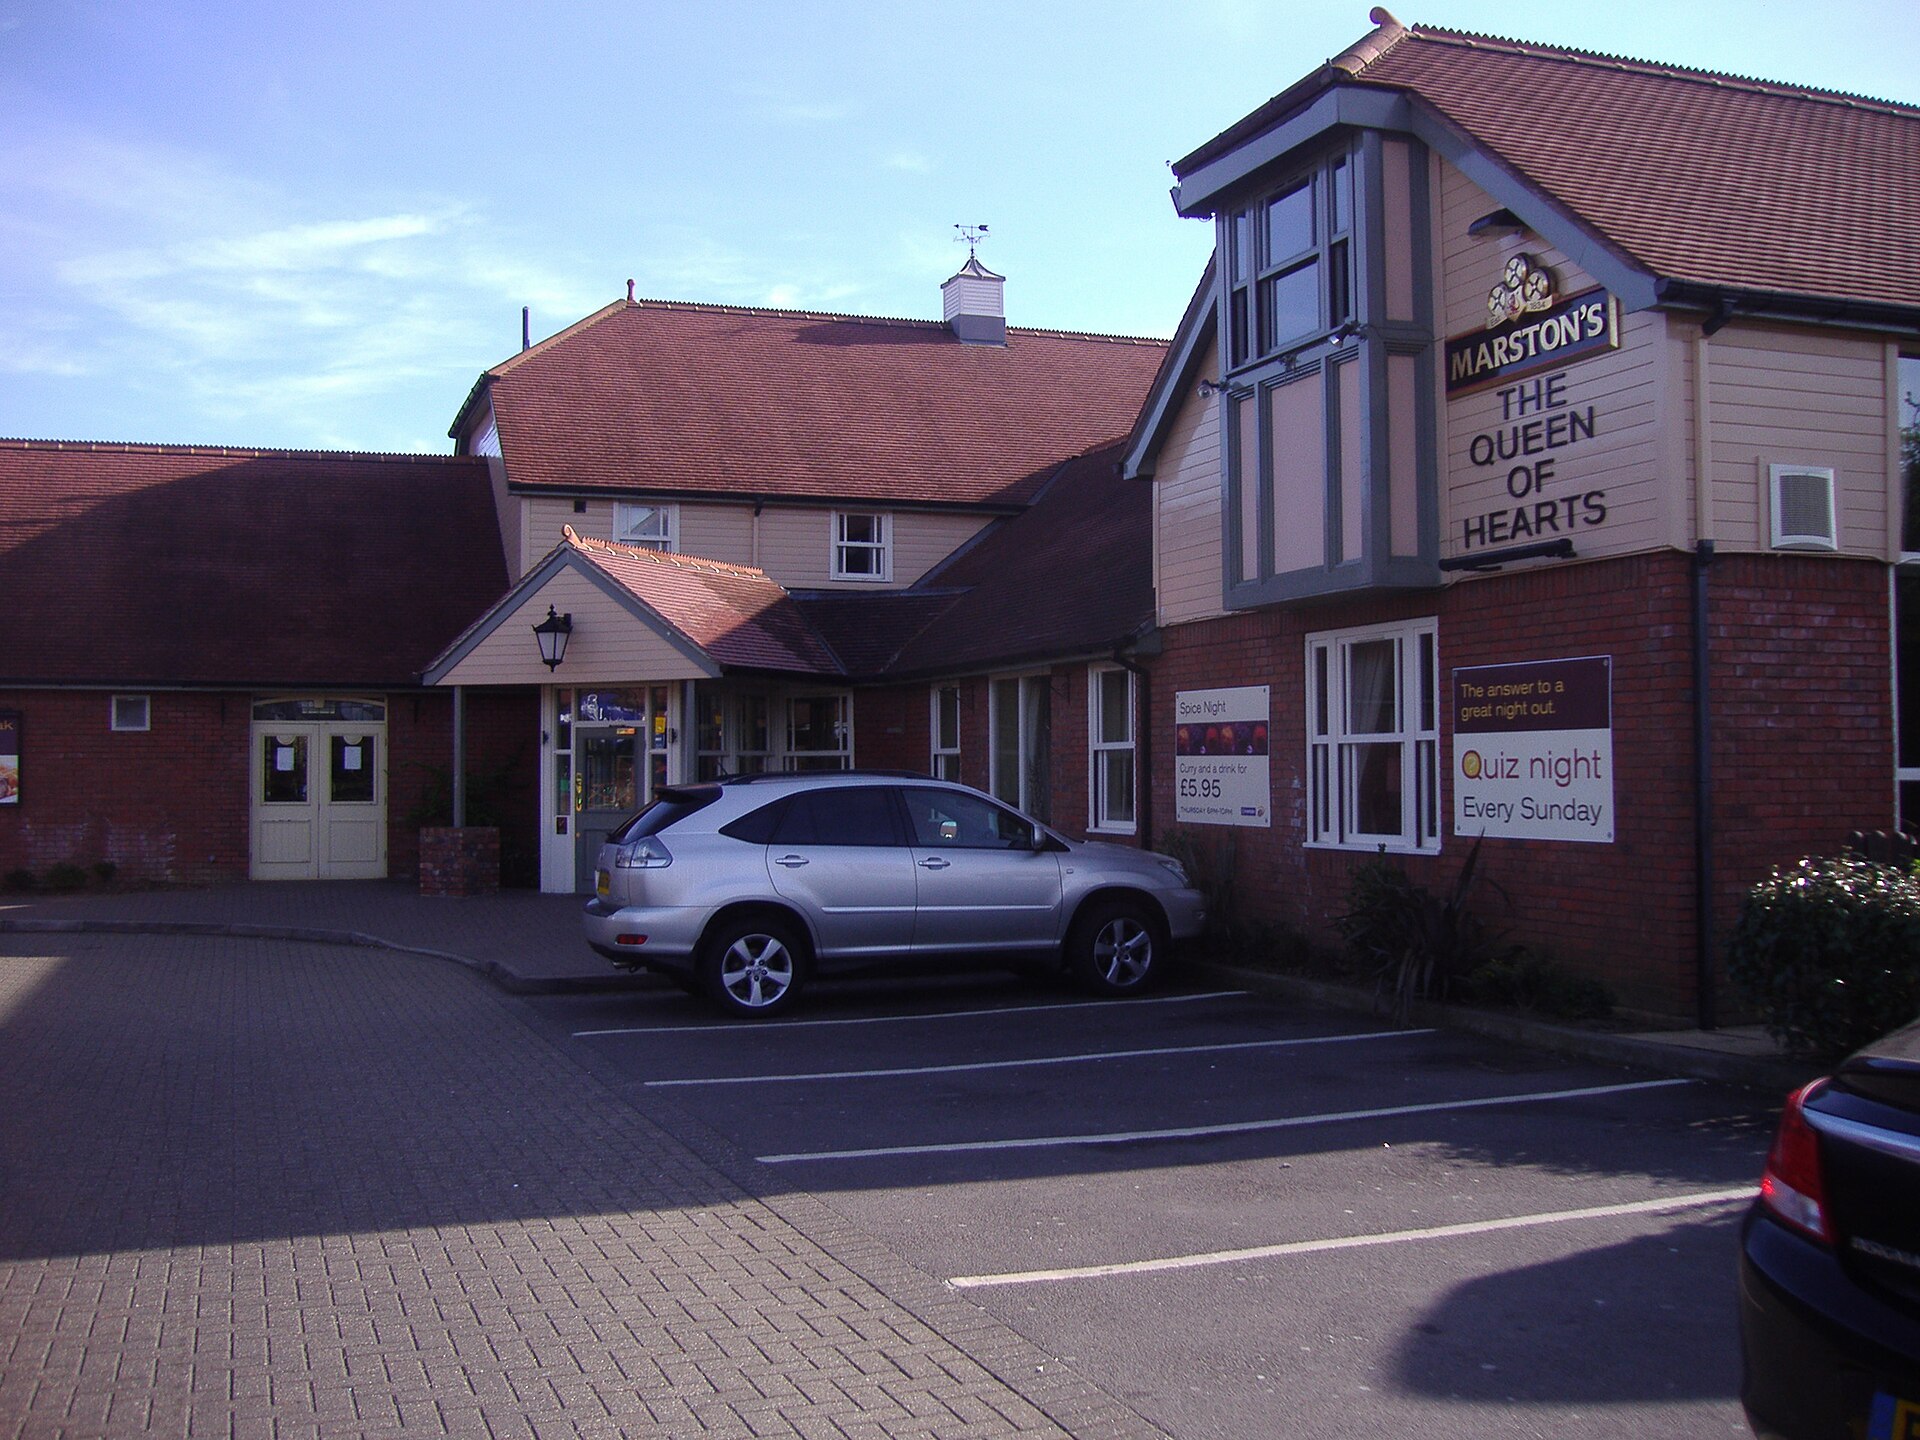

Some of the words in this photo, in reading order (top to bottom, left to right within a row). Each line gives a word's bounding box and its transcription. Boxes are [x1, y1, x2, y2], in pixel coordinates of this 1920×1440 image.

[1451, 303, 1604, 381] MARSTON'S
[1496, 372, 1567, 421] THE
[1469, 406, 1595, 467] QUEEN
[1507, 458, 1555, 499] OF
[1463, 490, 1607, 549] HEARTS
[1461, 683, 1484, 698] The
[1487, 682, 1535, 697] answer
[1538, 681, 1550, 693] to
[1555, 680, 1564, 693] a
[1180, 702, 1201, 717] Spice
[1203, 700, 1226, 716] Night
[1461, 704, 1492, 721] great
[1495, 701, 1527, 719] night
[1180, 763, 1197, 775] Curry
[1198, 763, 1211, 774] and
[1219, 763, 1236, 774] drink
[1238, 763, 1248, 774] for
[1462, 750, 1520, 780] Quiz
[1530, 748, 1602, 787] night
[1180, 779, 1221, 798] £5.95
[1181, 806, 1206, 815] THURSDAY
[1463, 796, 1514, 823] Every
[1521, 797, 1602, 826] Sunday
